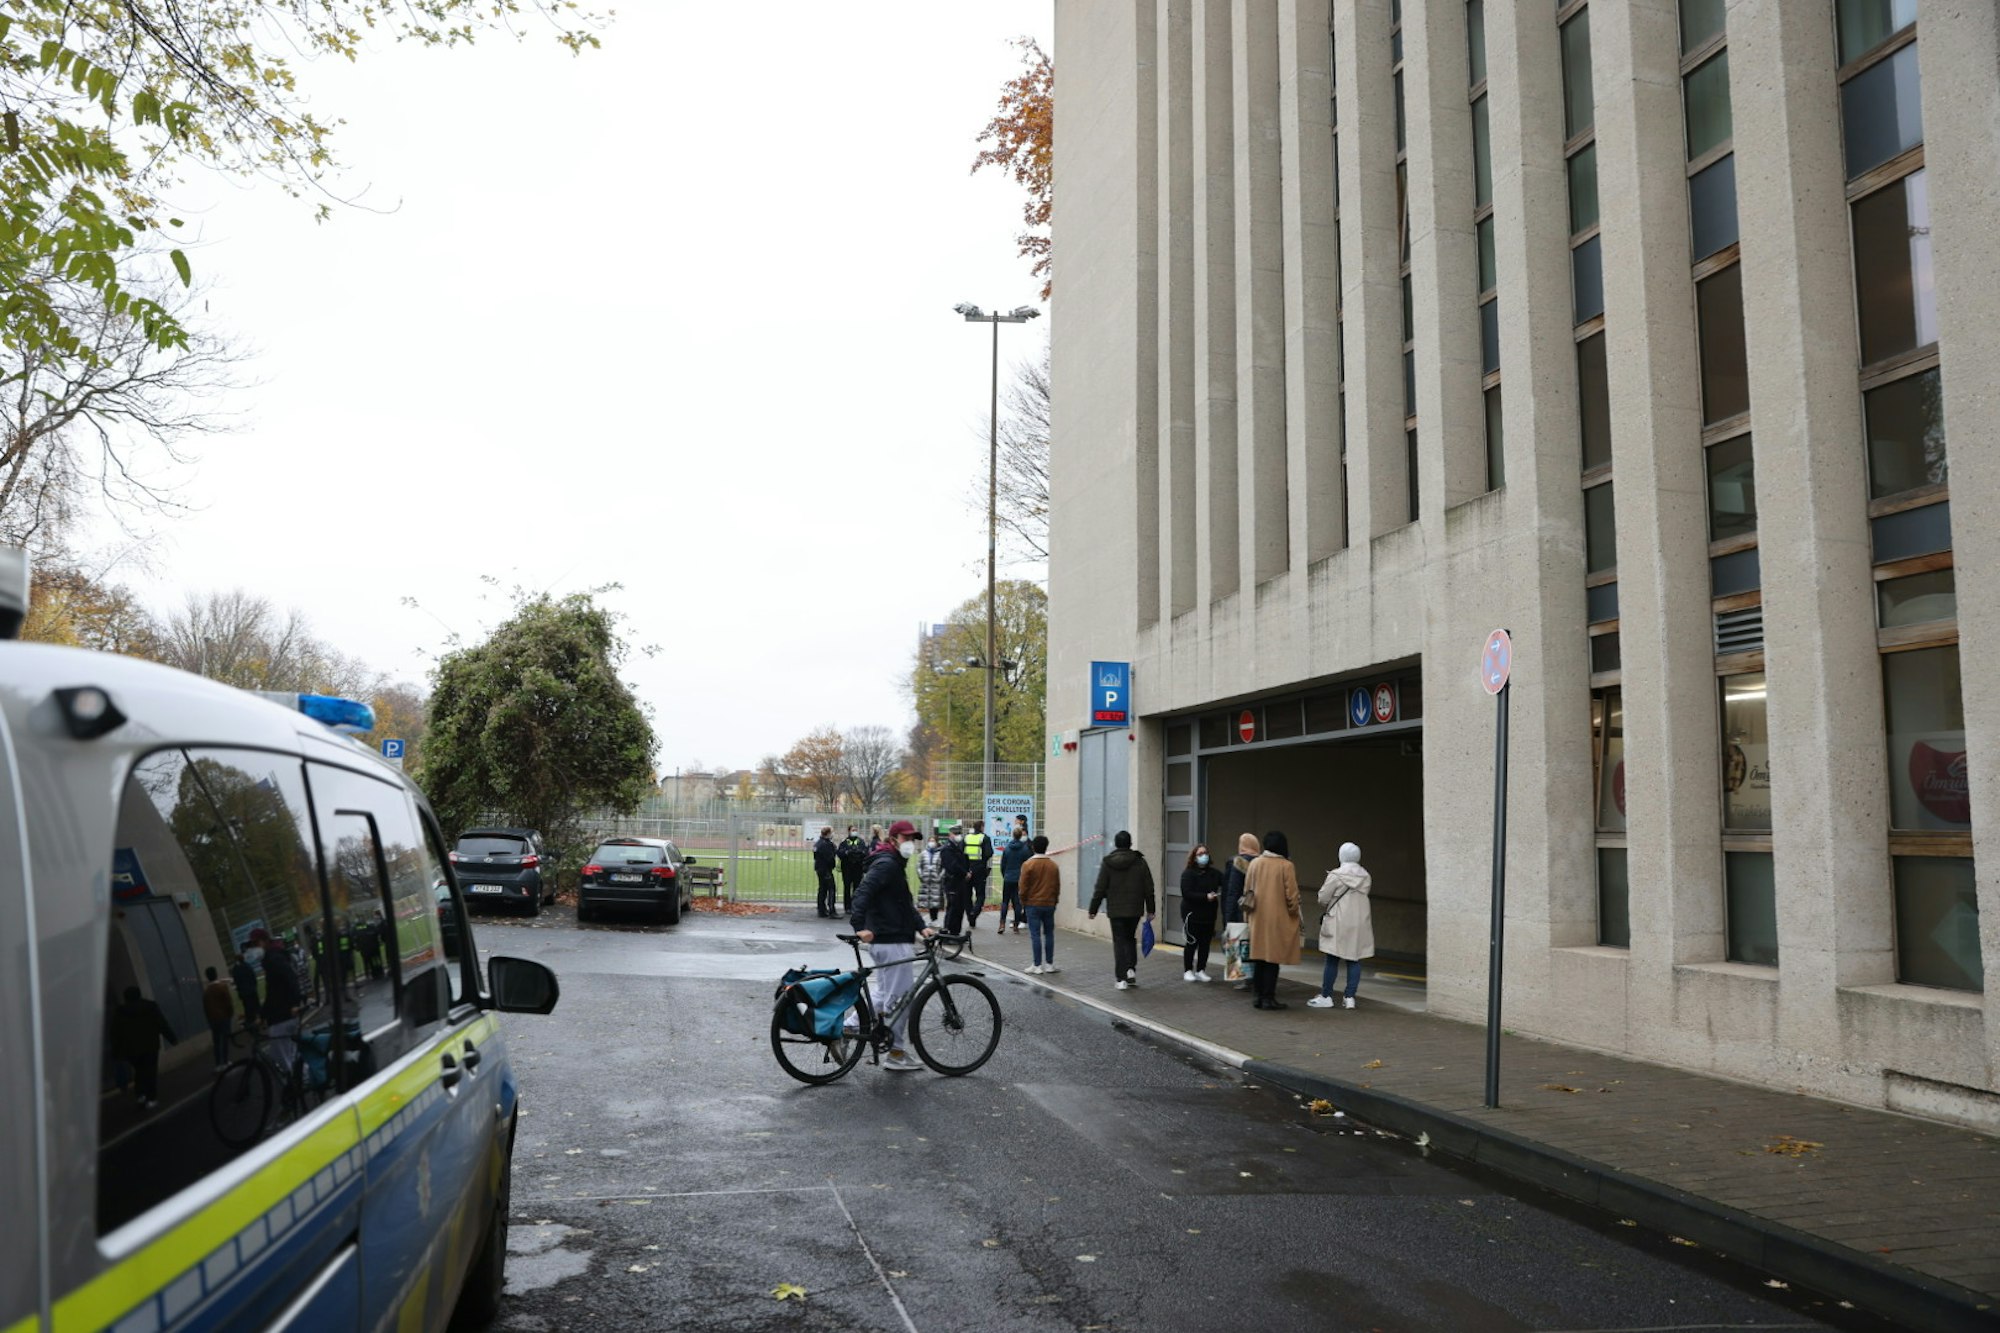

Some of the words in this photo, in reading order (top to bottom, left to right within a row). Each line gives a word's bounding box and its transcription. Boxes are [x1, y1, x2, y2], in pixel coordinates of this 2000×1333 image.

[1106, 691, 1118, 708] P
[387, 742, 399, 757] P
[994, 838, 1010, 847] Einf
